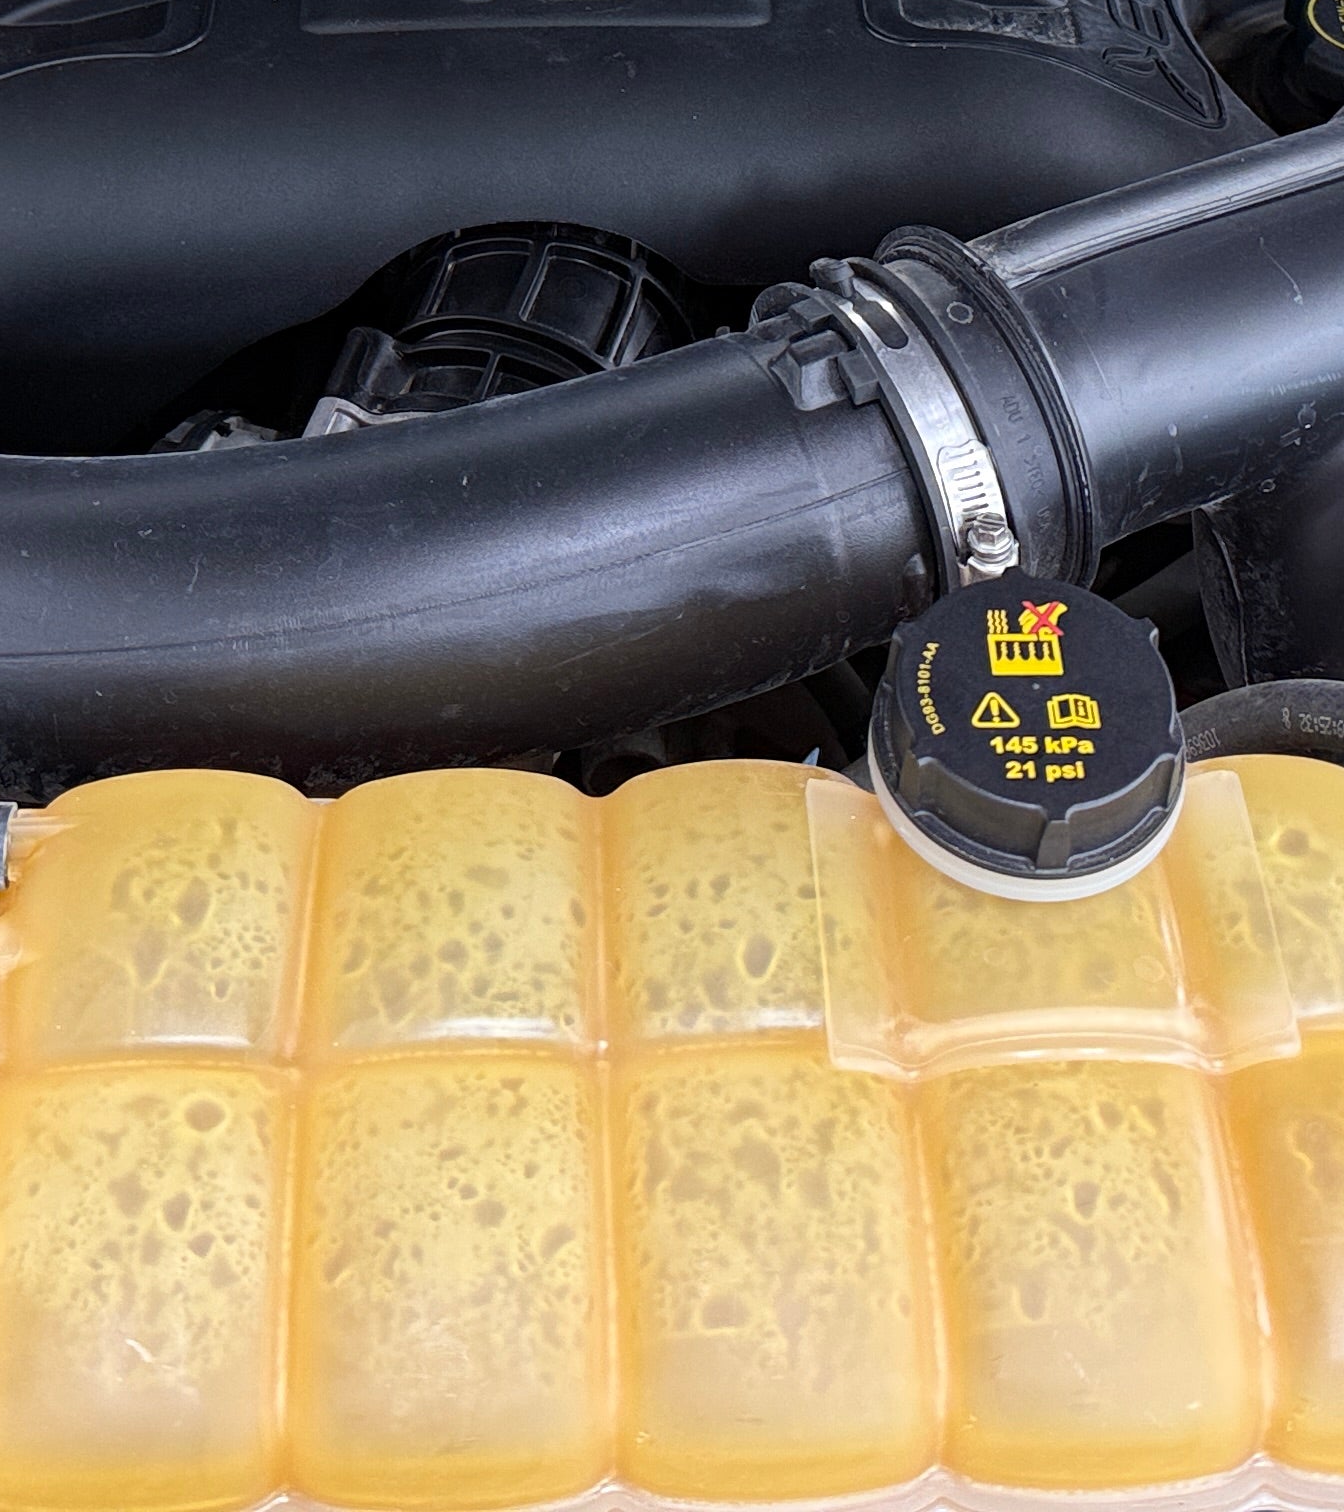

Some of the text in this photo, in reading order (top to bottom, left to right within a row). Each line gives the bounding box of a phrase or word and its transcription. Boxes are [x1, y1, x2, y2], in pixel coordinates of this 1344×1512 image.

[989, 735, 1096, 756] 145 kPa
[1005, 759, 1086, 784] 21 psi
